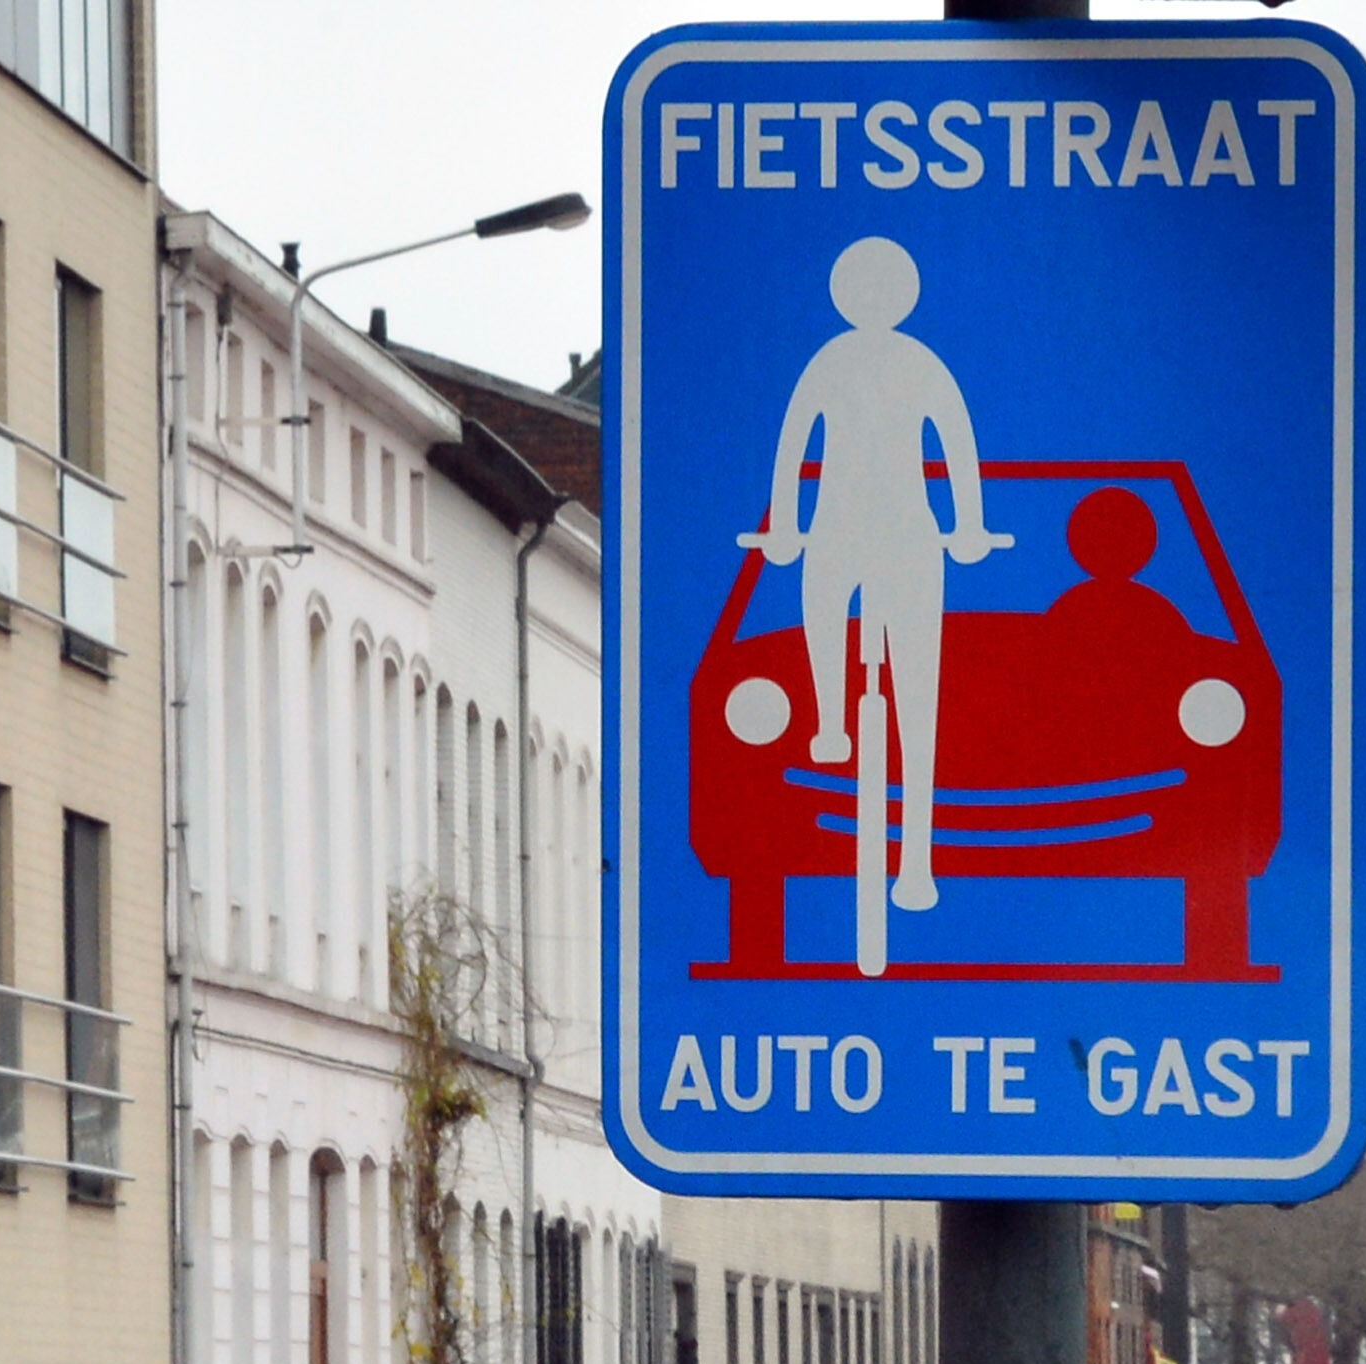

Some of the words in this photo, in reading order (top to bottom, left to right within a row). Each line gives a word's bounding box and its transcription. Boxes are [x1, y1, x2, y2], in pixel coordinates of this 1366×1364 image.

[660, 100, 1317, 189] FIETSSTRAAT
[659, 1034, 883, 1113] AUTO
[933, 1037, 1036, 1114] TE
[1087, 1037, 1310, 1118] GAST
